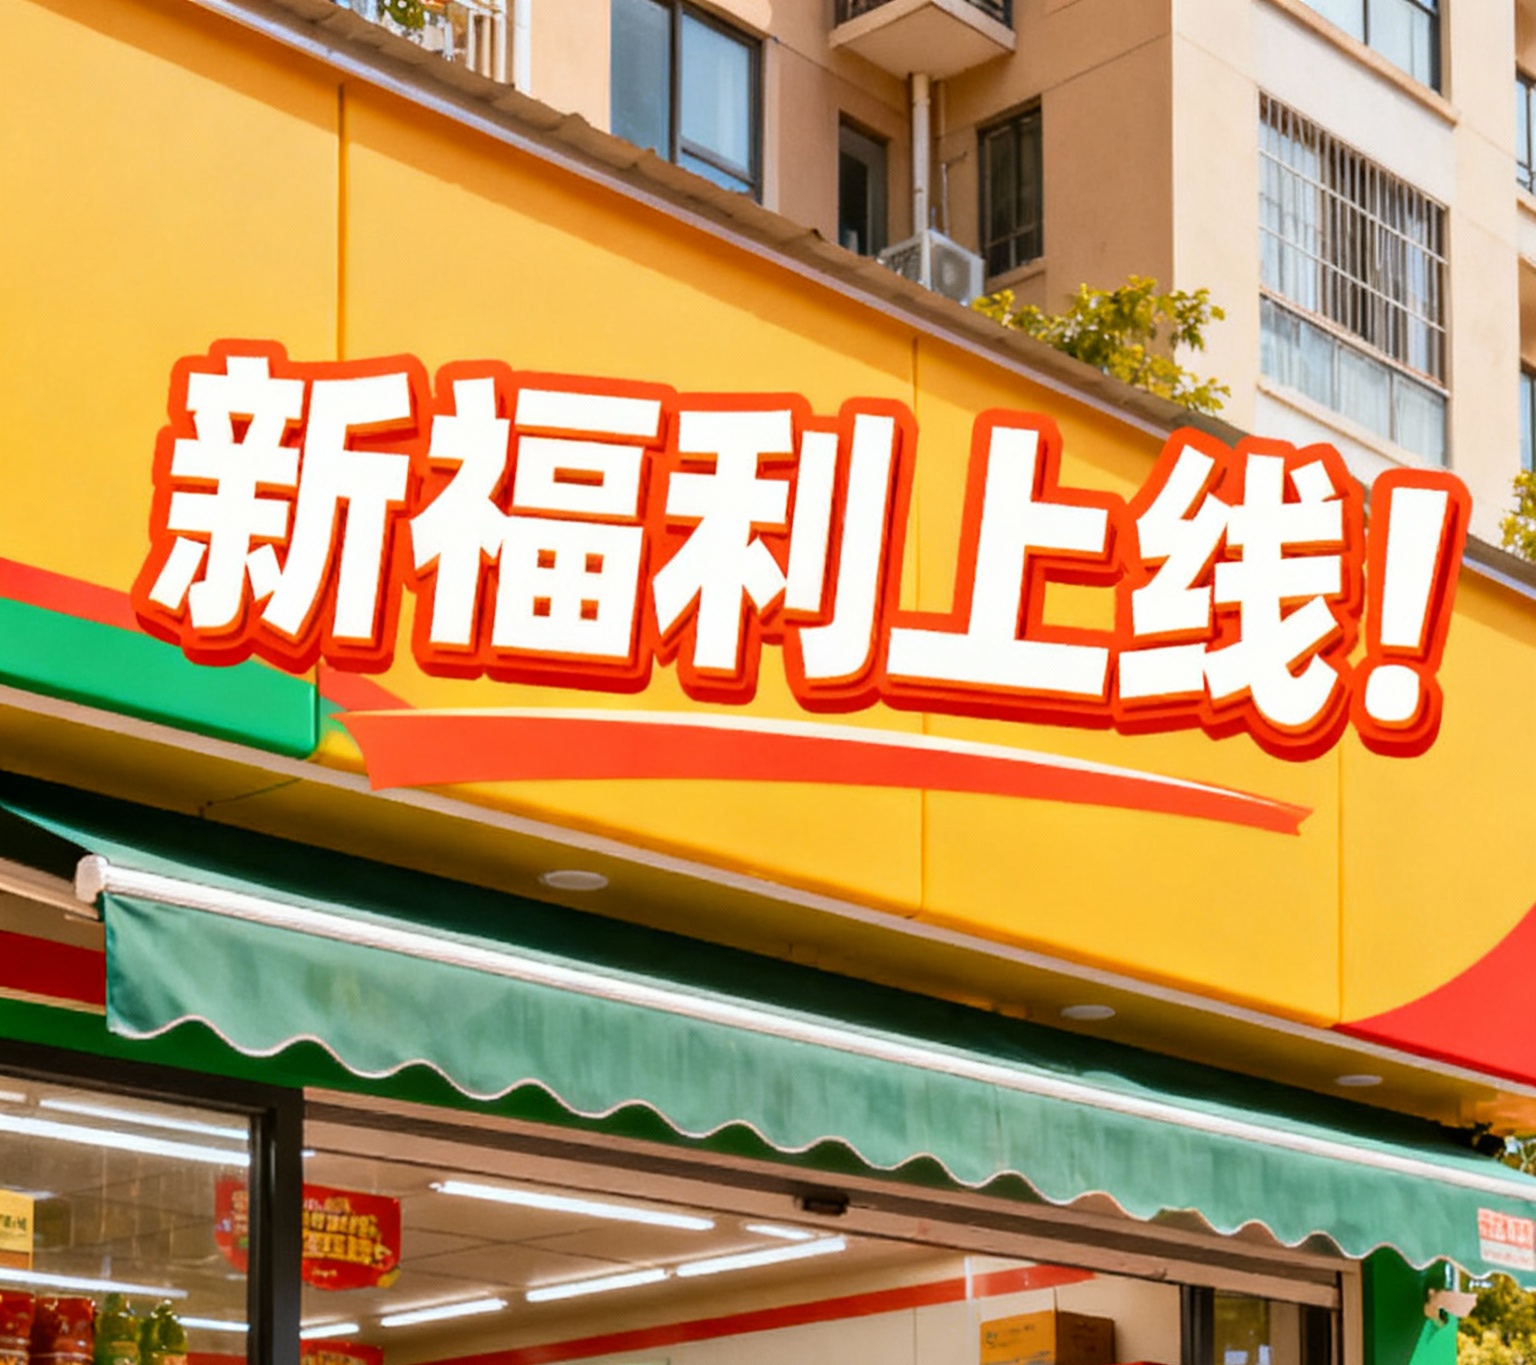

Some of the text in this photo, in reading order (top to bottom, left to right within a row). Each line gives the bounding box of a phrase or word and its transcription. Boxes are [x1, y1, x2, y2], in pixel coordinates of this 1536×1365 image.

[150, 355, 1450, 728] 新福利上线!
